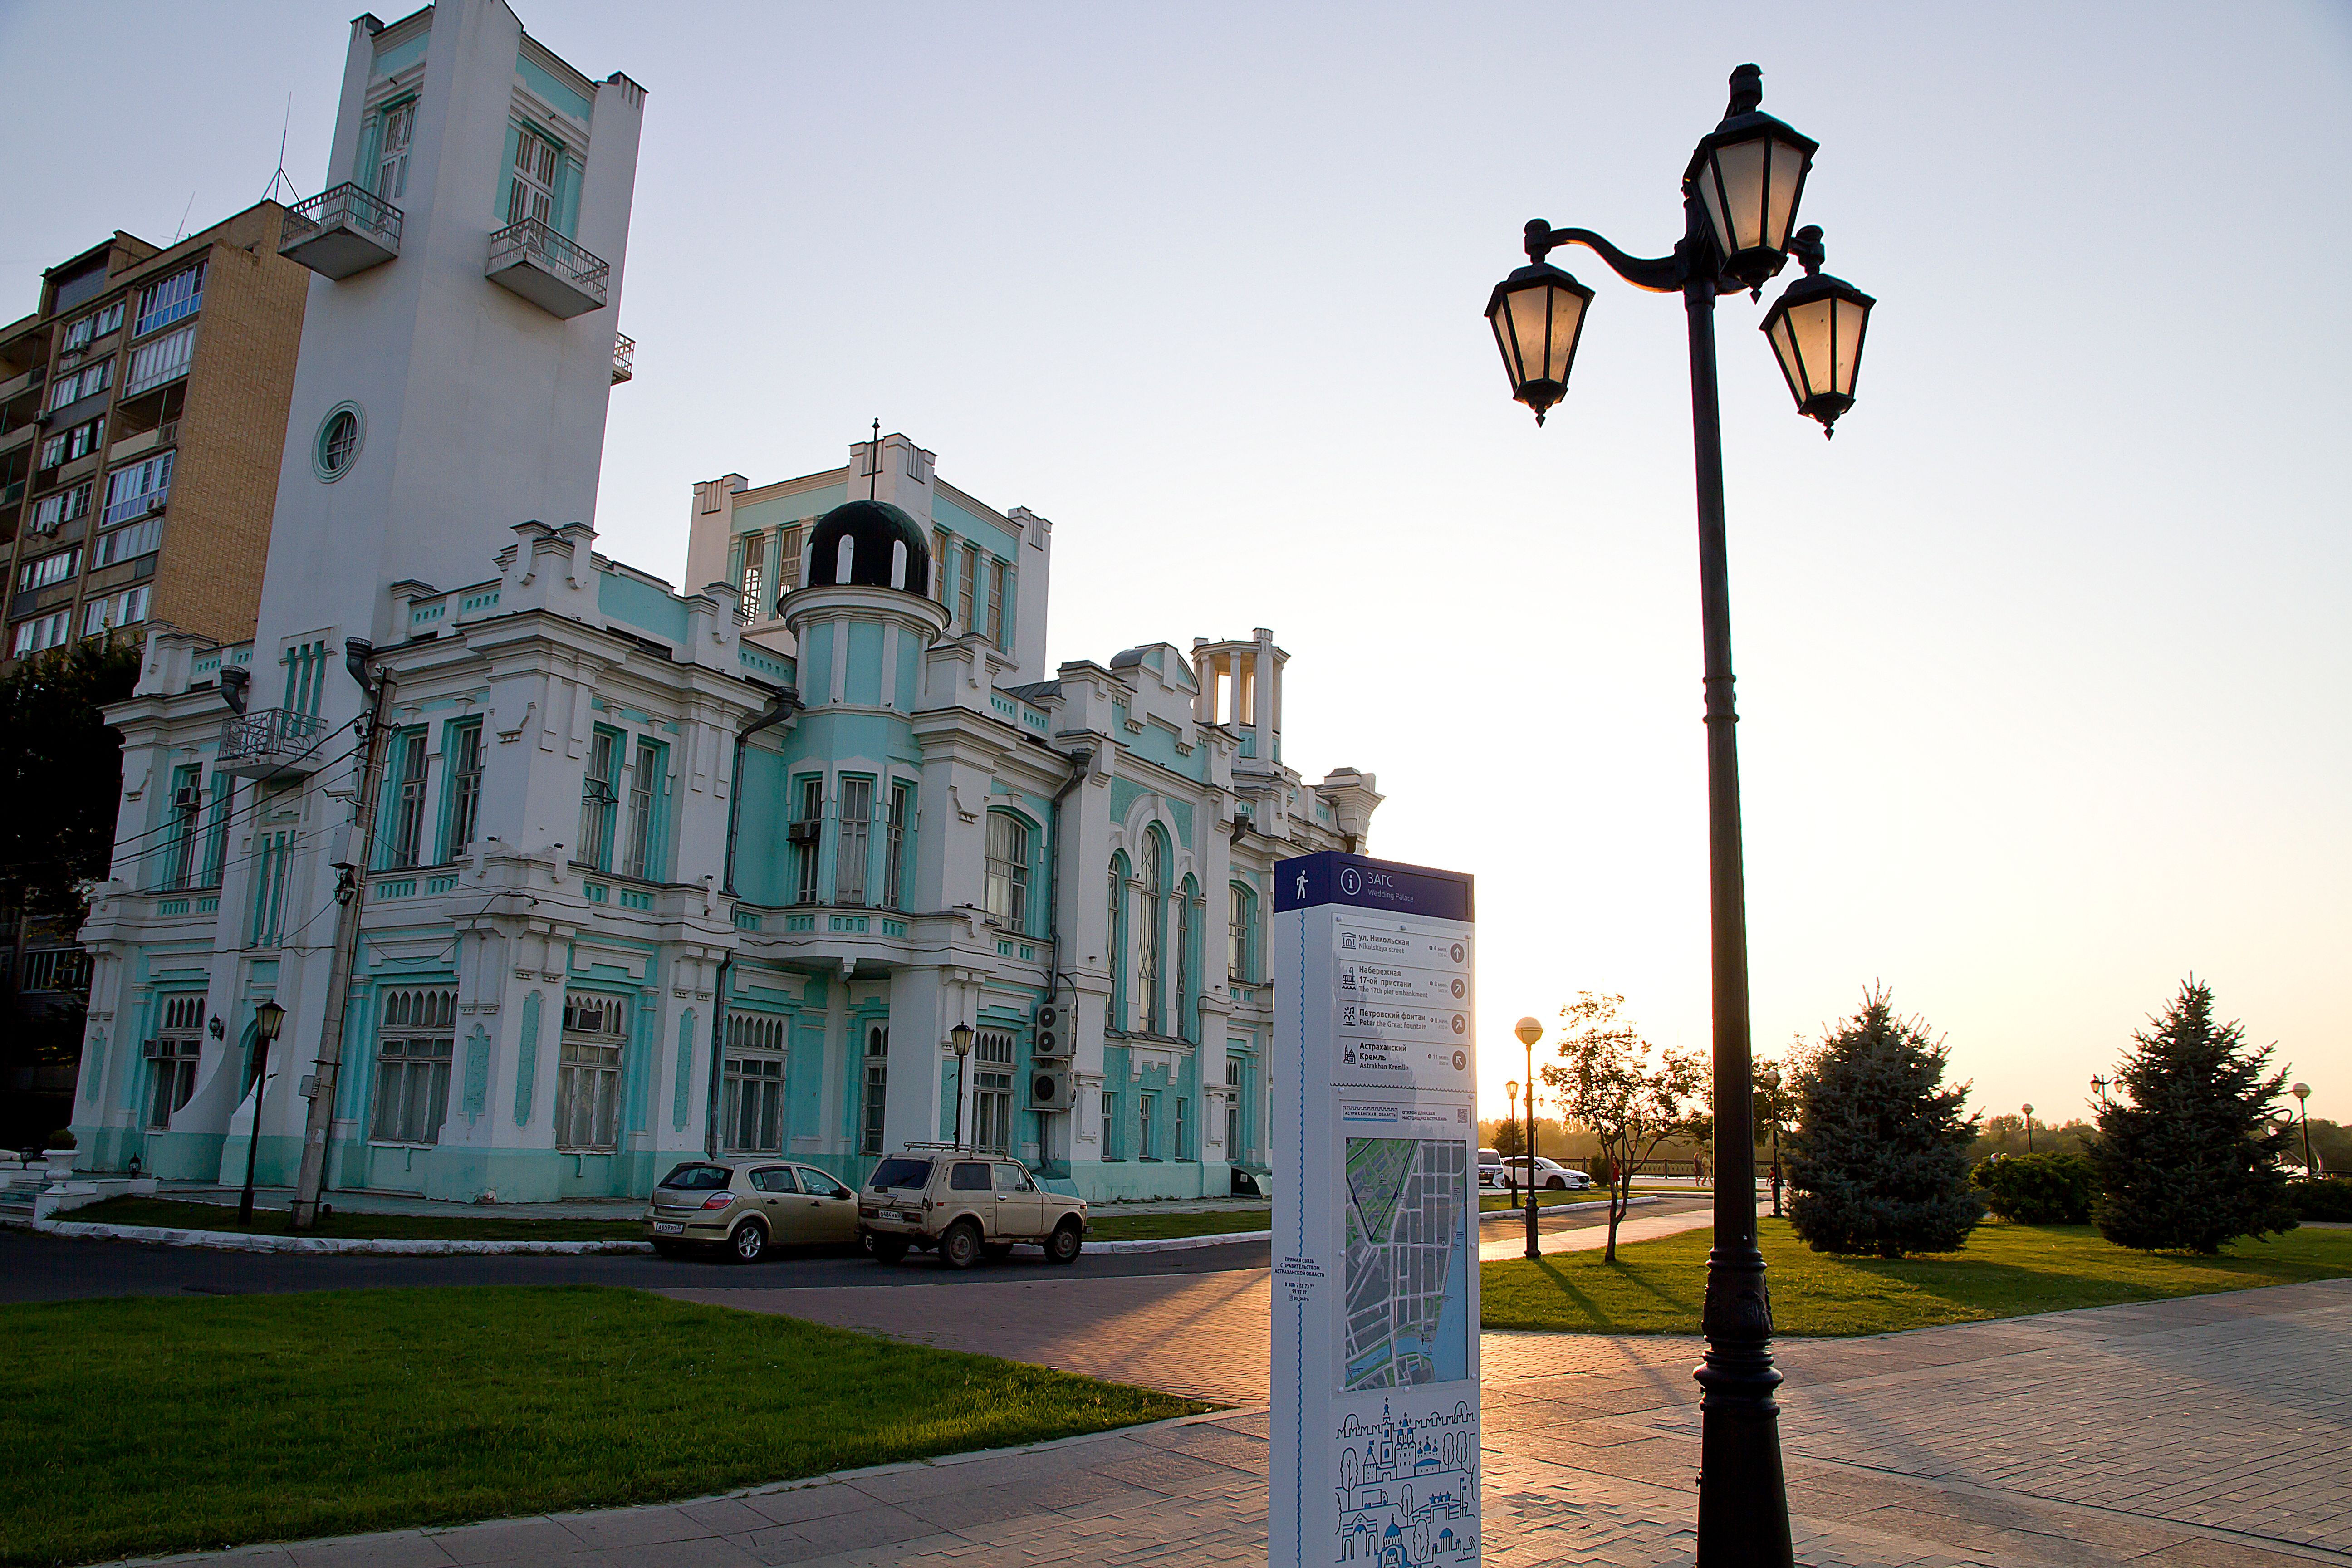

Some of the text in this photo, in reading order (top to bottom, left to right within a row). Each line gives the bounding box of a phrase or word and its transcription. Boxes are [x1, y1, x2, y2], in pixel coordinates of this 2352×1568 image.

[1368, 872, 1393, 887] ЗАГС
[1368, 889, 1414, 902] Wedding Palace
[1370, 935, 1409, 946] Никольская
[1359, 943, 1387, 952] Nikolskaya
[1359, 966, 1401, 976] Набережная
[1359, 976, 1378, 985] 17-ой
[1395, 990, 1428, 998] embankment
[1360, 1009, 1425, 1021] Петровский фонтан
[1360, 1042, 1406, 1052] Астраханский
[1360, 1053, 1386, 1061] Кремль
